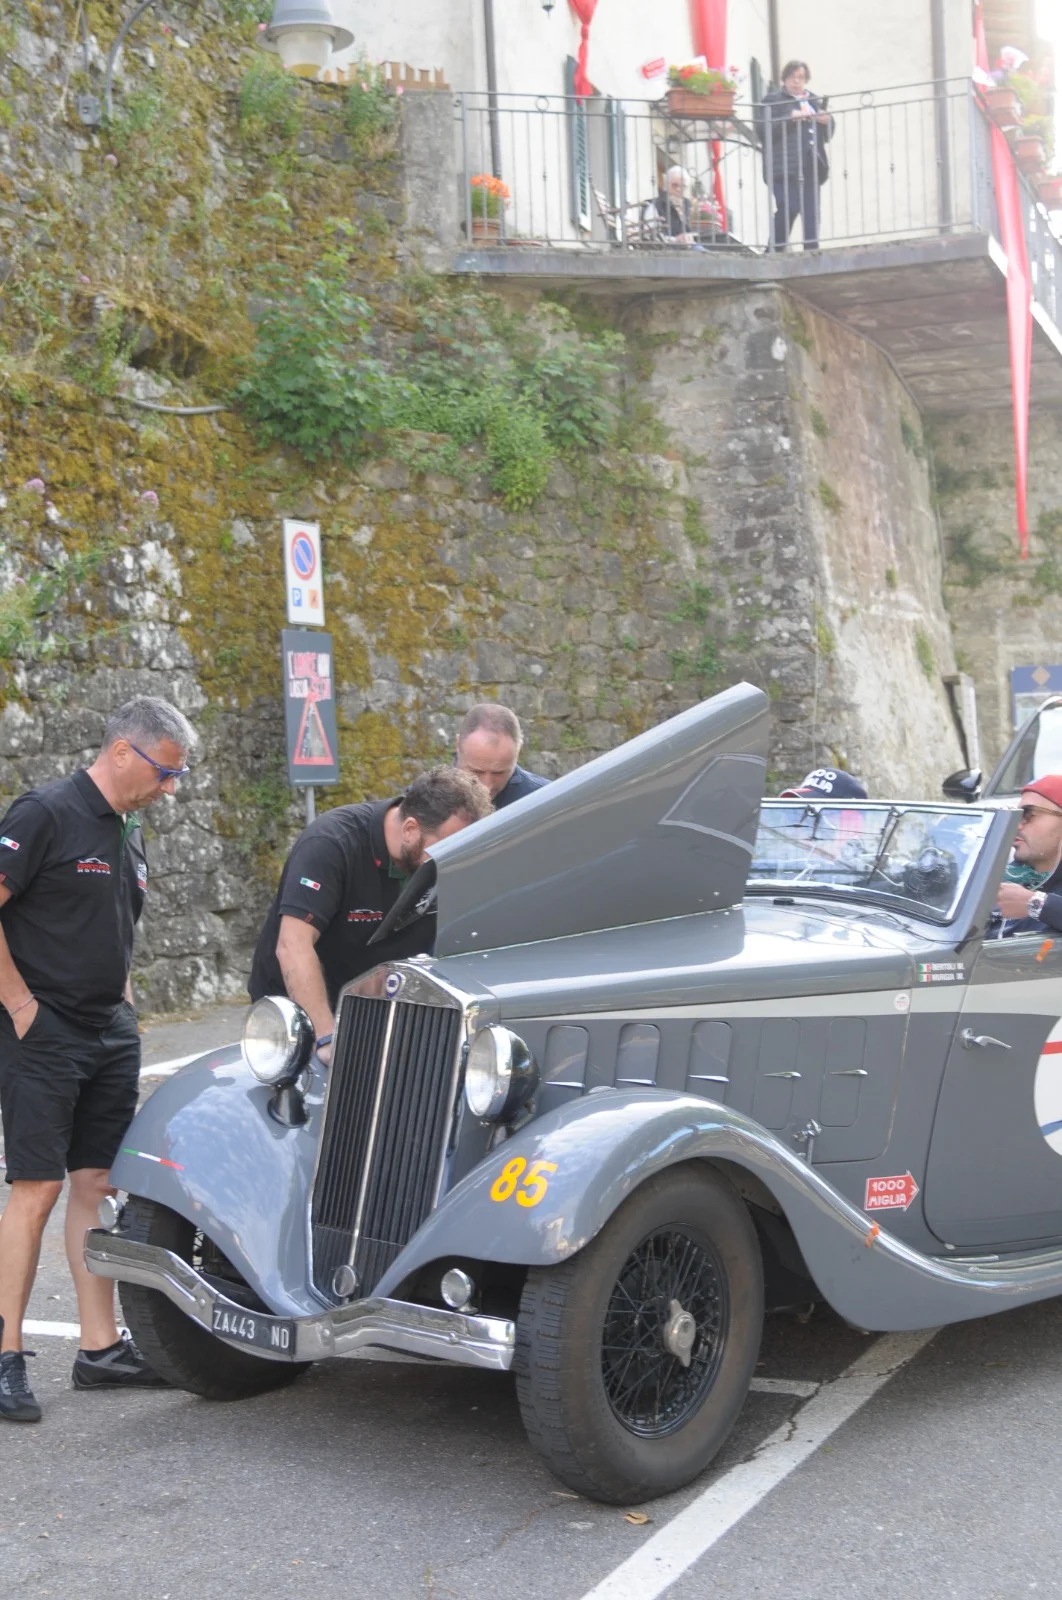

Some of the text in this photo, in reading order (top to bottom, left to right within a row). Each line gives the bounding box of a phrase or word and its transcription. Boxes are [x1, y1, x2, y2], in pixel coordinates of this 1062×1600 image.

[489, 1156, 559, 1208] 85
[872, 1179, 906, 1193] 1000
[868, 1193, 907, 1207] MIGLIA
[213, 1310, 290, 1349] ZA443 ND
